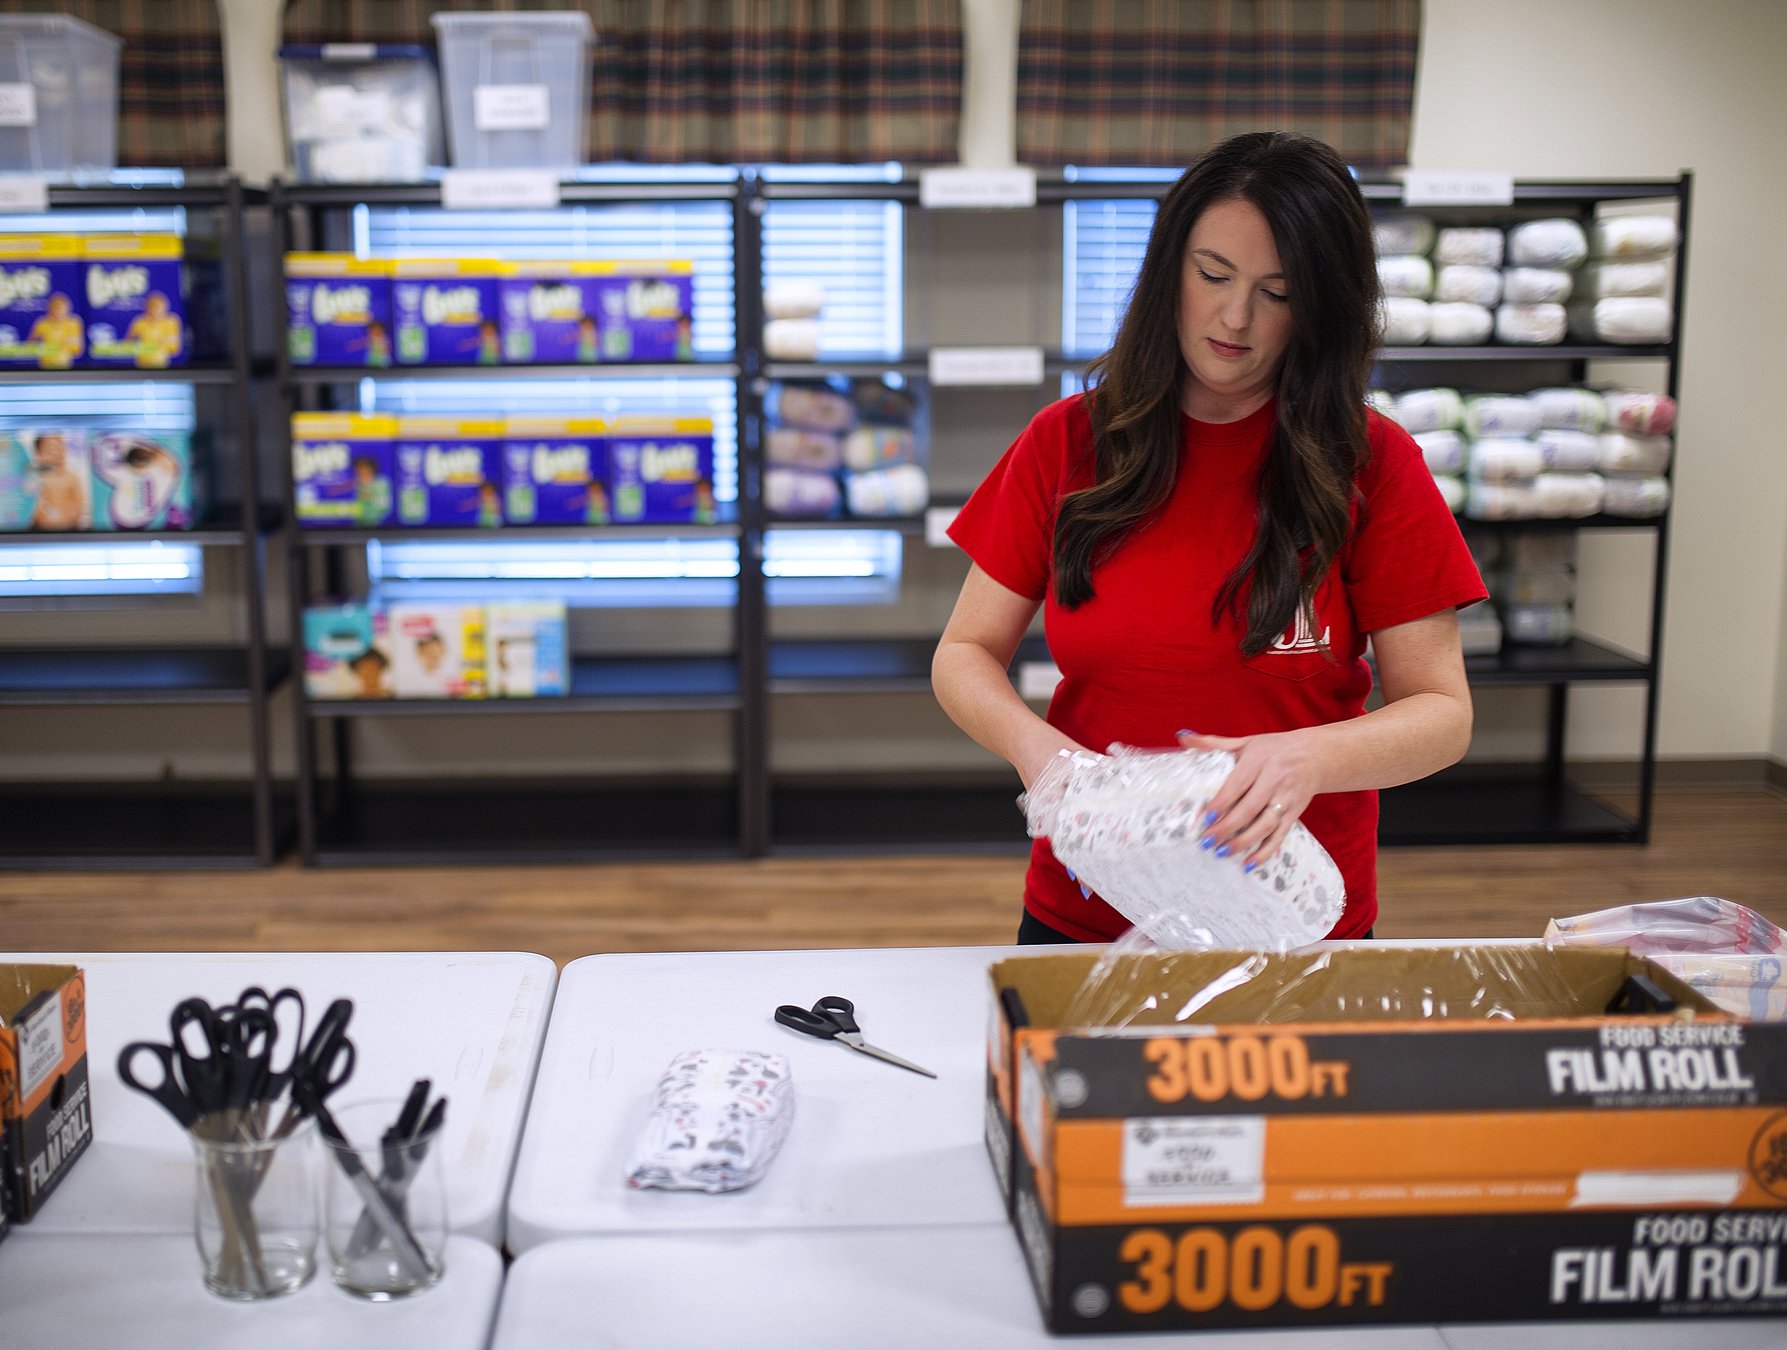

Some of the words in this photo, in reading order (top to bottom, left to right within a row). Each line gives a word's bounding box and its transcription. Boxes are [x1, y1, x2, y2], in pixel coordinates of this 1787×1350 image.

[1601, 1026, 1656, 1048] FOOD
[1658, 1023, 1745, 1046] SERVICE
[1547, 1050, 1645, 1093] FILM
[1649, 1047, 1753, 1090] ROLL
[1634, 1217, 1709, 1244] FOOD
[1552, 1249, 1678, 1303] FILM
